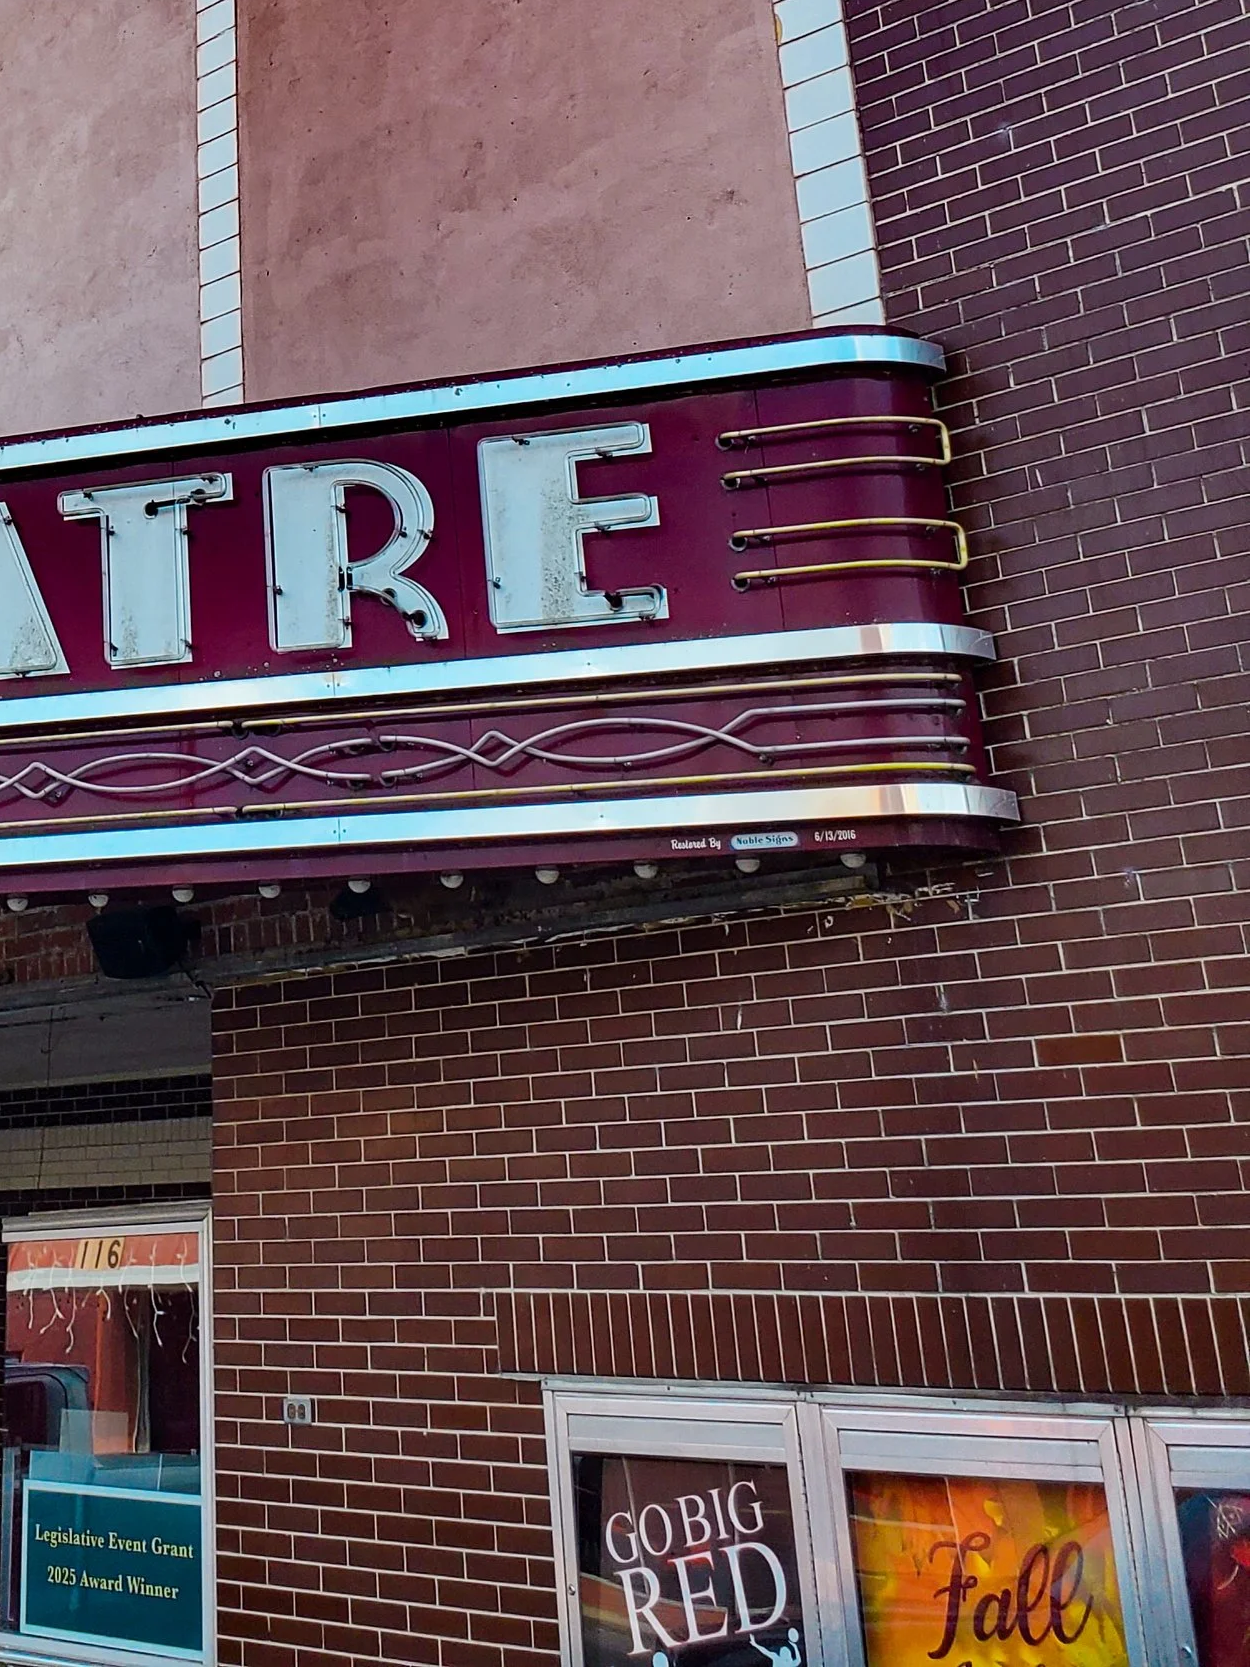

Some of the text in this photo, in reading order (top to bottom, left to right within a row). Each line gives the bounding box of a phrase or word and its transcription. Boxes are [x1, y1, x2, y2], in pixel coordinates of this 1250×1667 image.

[670, 829, 857, 850] Restored By Noble Signs 6/13/2016
[80, 1239, 121, 1270] 116
[605, 1479, 765, 1564] GO BIG
[35, 1524, 194, 1559] Legislative Event Grant
[47, 1565, 180, 1599] 2025 Award Winner
[613, 1540, 788, 1657] RED
[927, 1532, 1095, 1659] Fall
